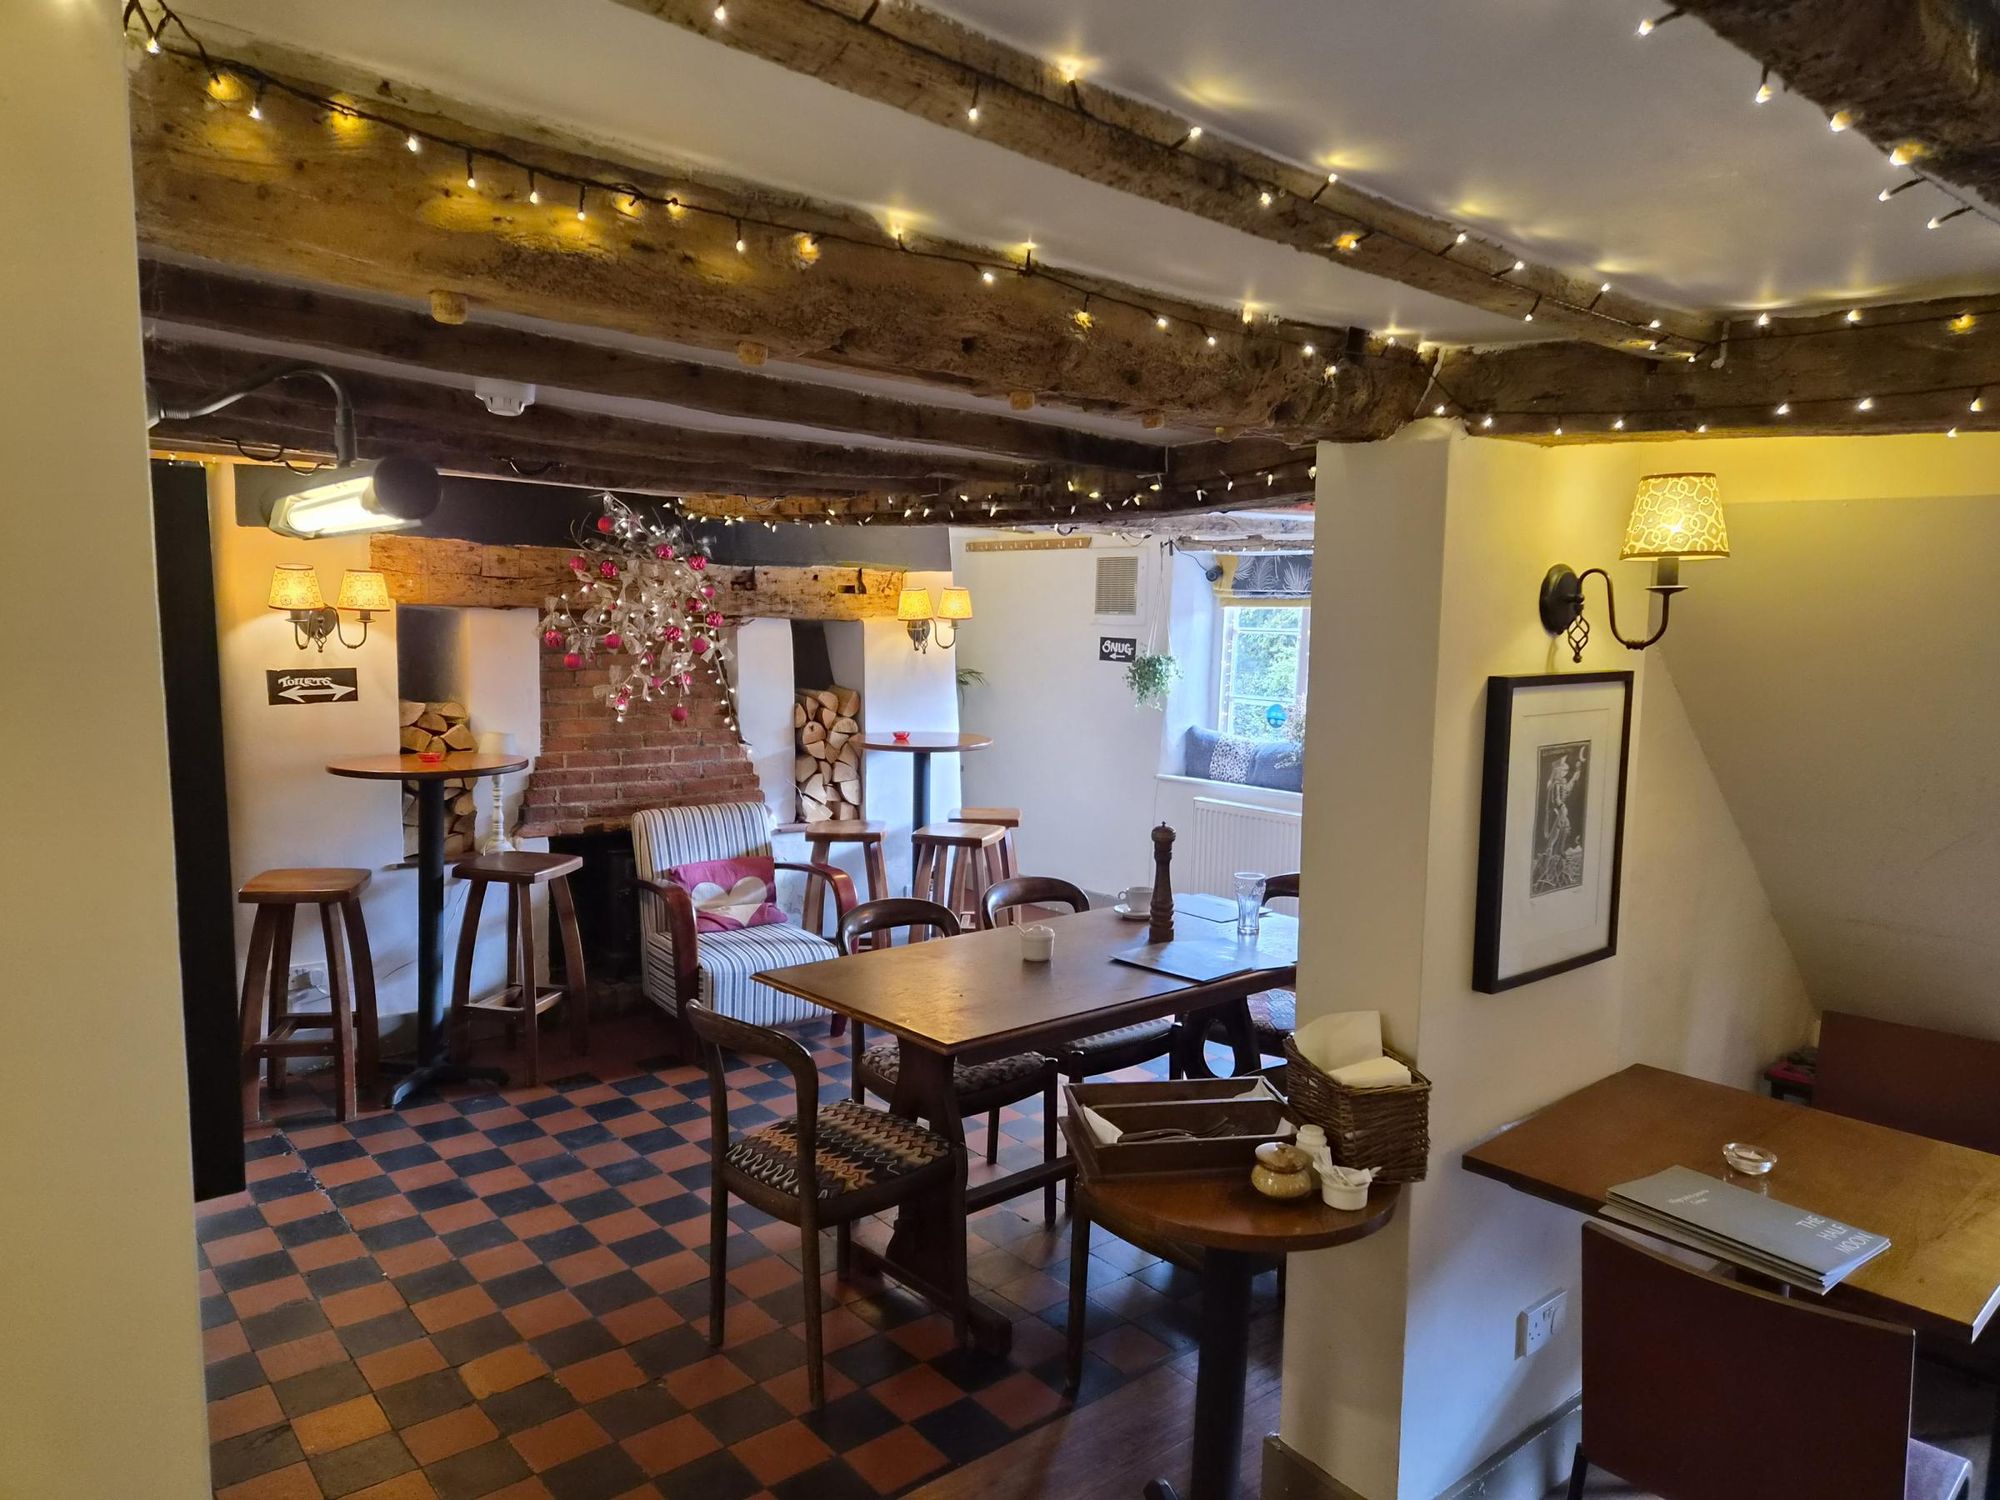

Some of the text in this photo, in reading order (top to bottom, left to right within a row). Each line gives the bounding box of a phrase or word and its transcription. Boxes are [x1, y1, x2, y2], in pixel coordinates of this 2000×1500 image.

[1102, 640, 1134, 656] SNUG
[1795, 1215, 1825, 1230] THE
[1816, 1223, 1848, 1241] HALF
[1834, 1231, 1874, 1255] MOON
